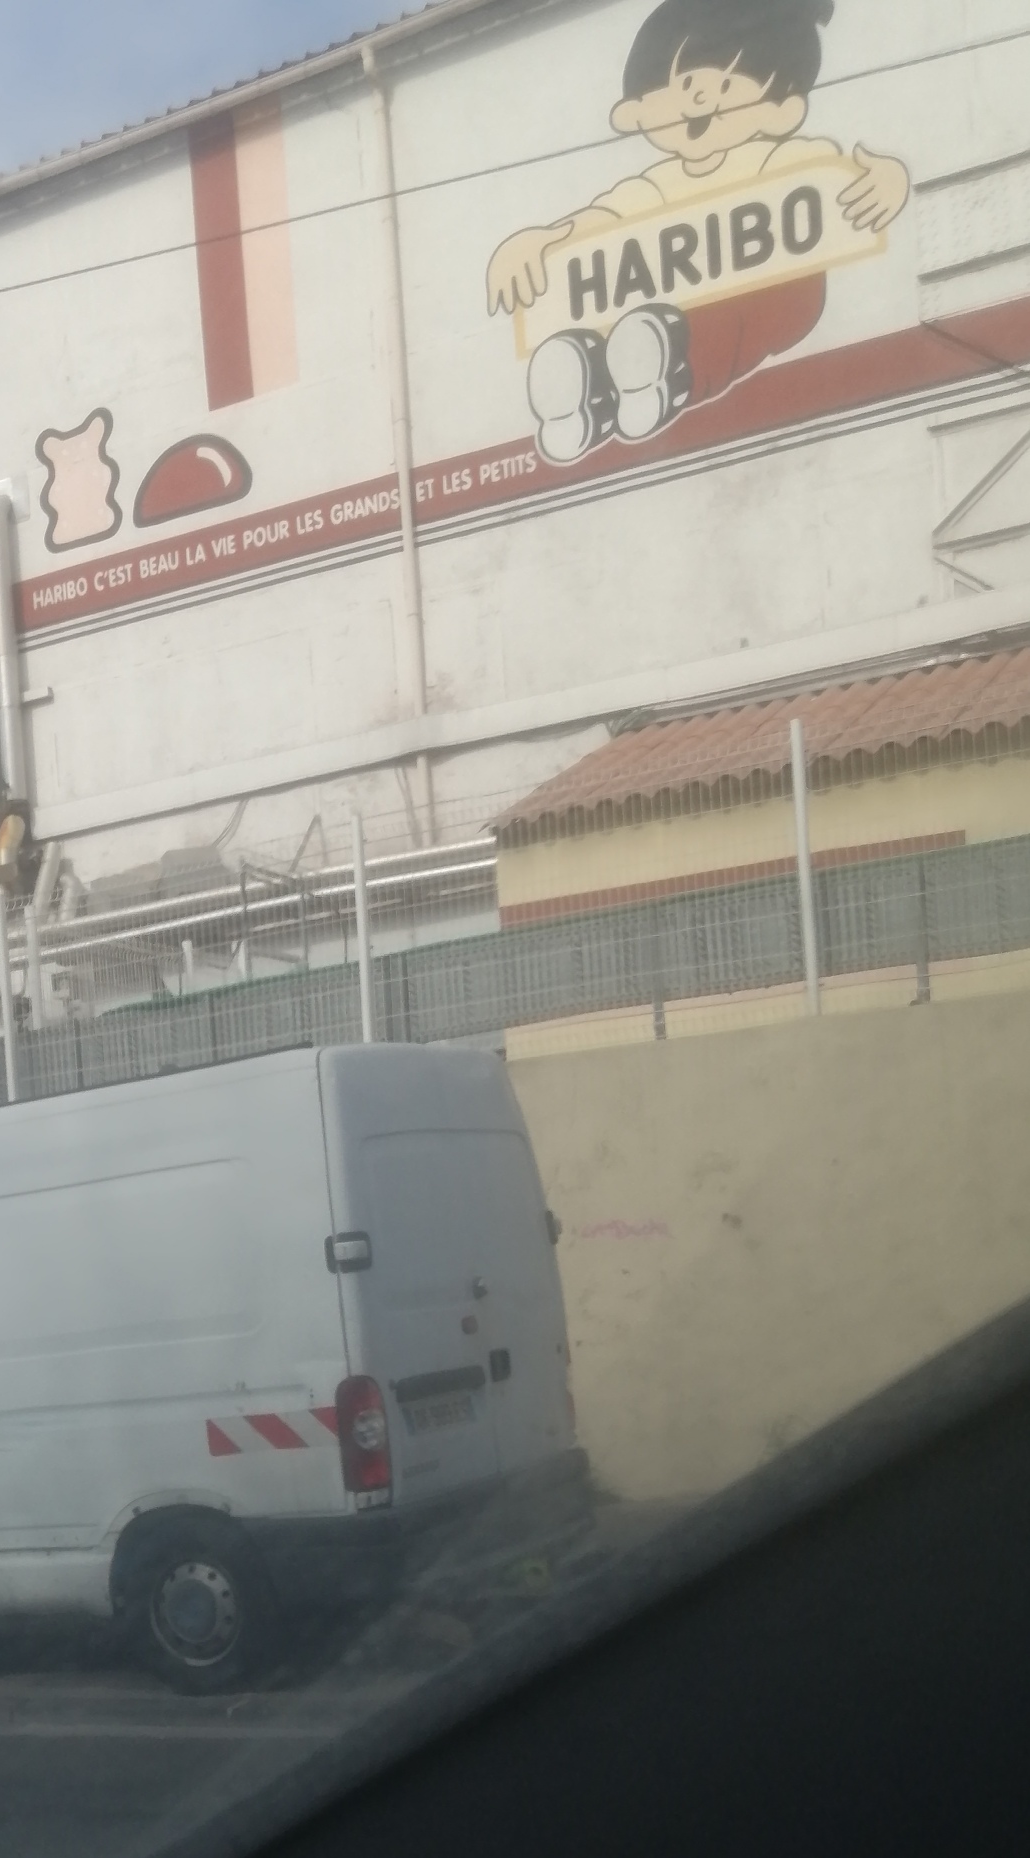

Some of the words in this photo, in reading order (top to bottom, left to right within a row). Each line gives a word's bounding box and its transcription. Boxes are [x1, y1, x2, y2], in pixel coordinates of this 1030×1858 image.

[567, 185, 823, 321] HARIBO
[32, 577, 88, 610] HARIBO
[93, 563, 133, 591] C'EST
[139, 551, 179, 579] BEAU
[185, 544, 206, 566] LA
[211, 534, 236, 559] VIE
[242, 520, 290, 550] POUR
[296, 509, 324, 535] LES
[330, 488, 401, 525] GRANDS
[415, 478, 434, 503] ET
[442, 468, 472, 495] LES
[479, 451, 537, 486] PETITS
